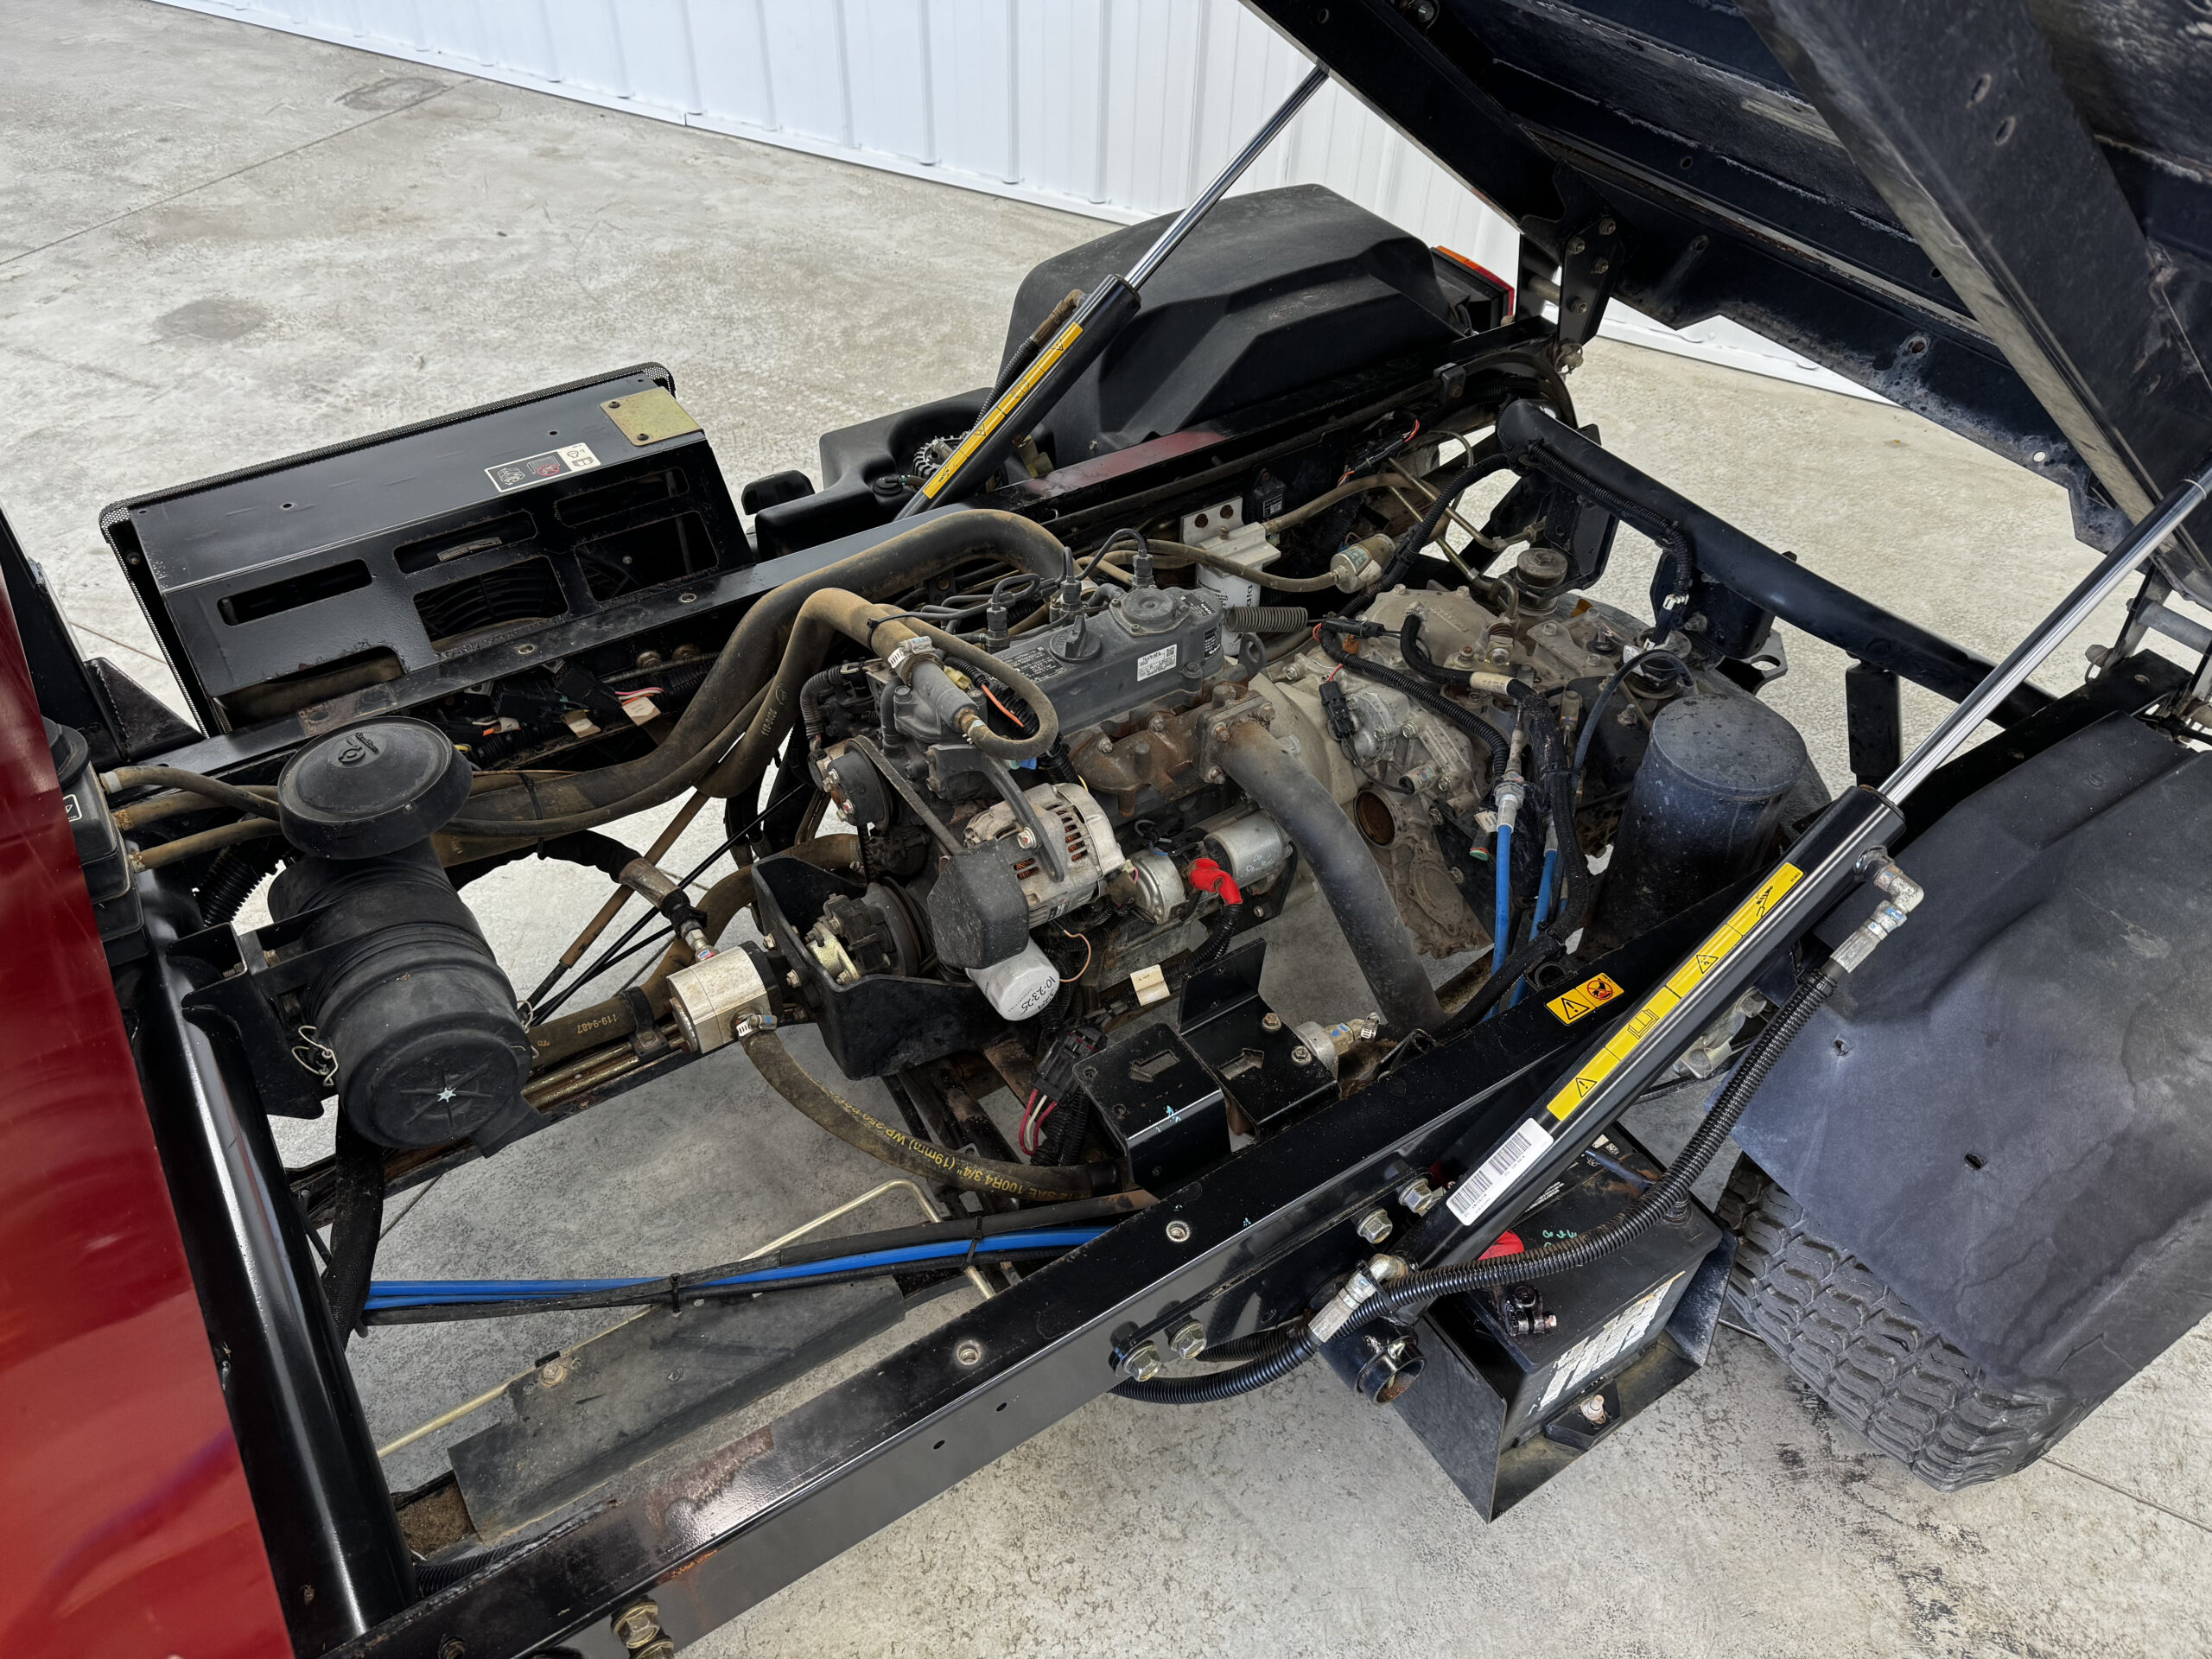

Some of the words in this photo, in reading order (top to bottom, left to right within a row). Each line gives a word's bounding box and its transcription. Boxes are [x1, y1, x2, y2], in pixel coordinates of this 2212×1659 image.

[576, 1014, 618, 1034] 119-9487
[886, 1128, 906, 1146] WP
[908, 1139, 956, 1171] (19mm)
[957, 1167, 984, 1183] 3/4"
[985, 1174, 1023, 1195] 100R4
